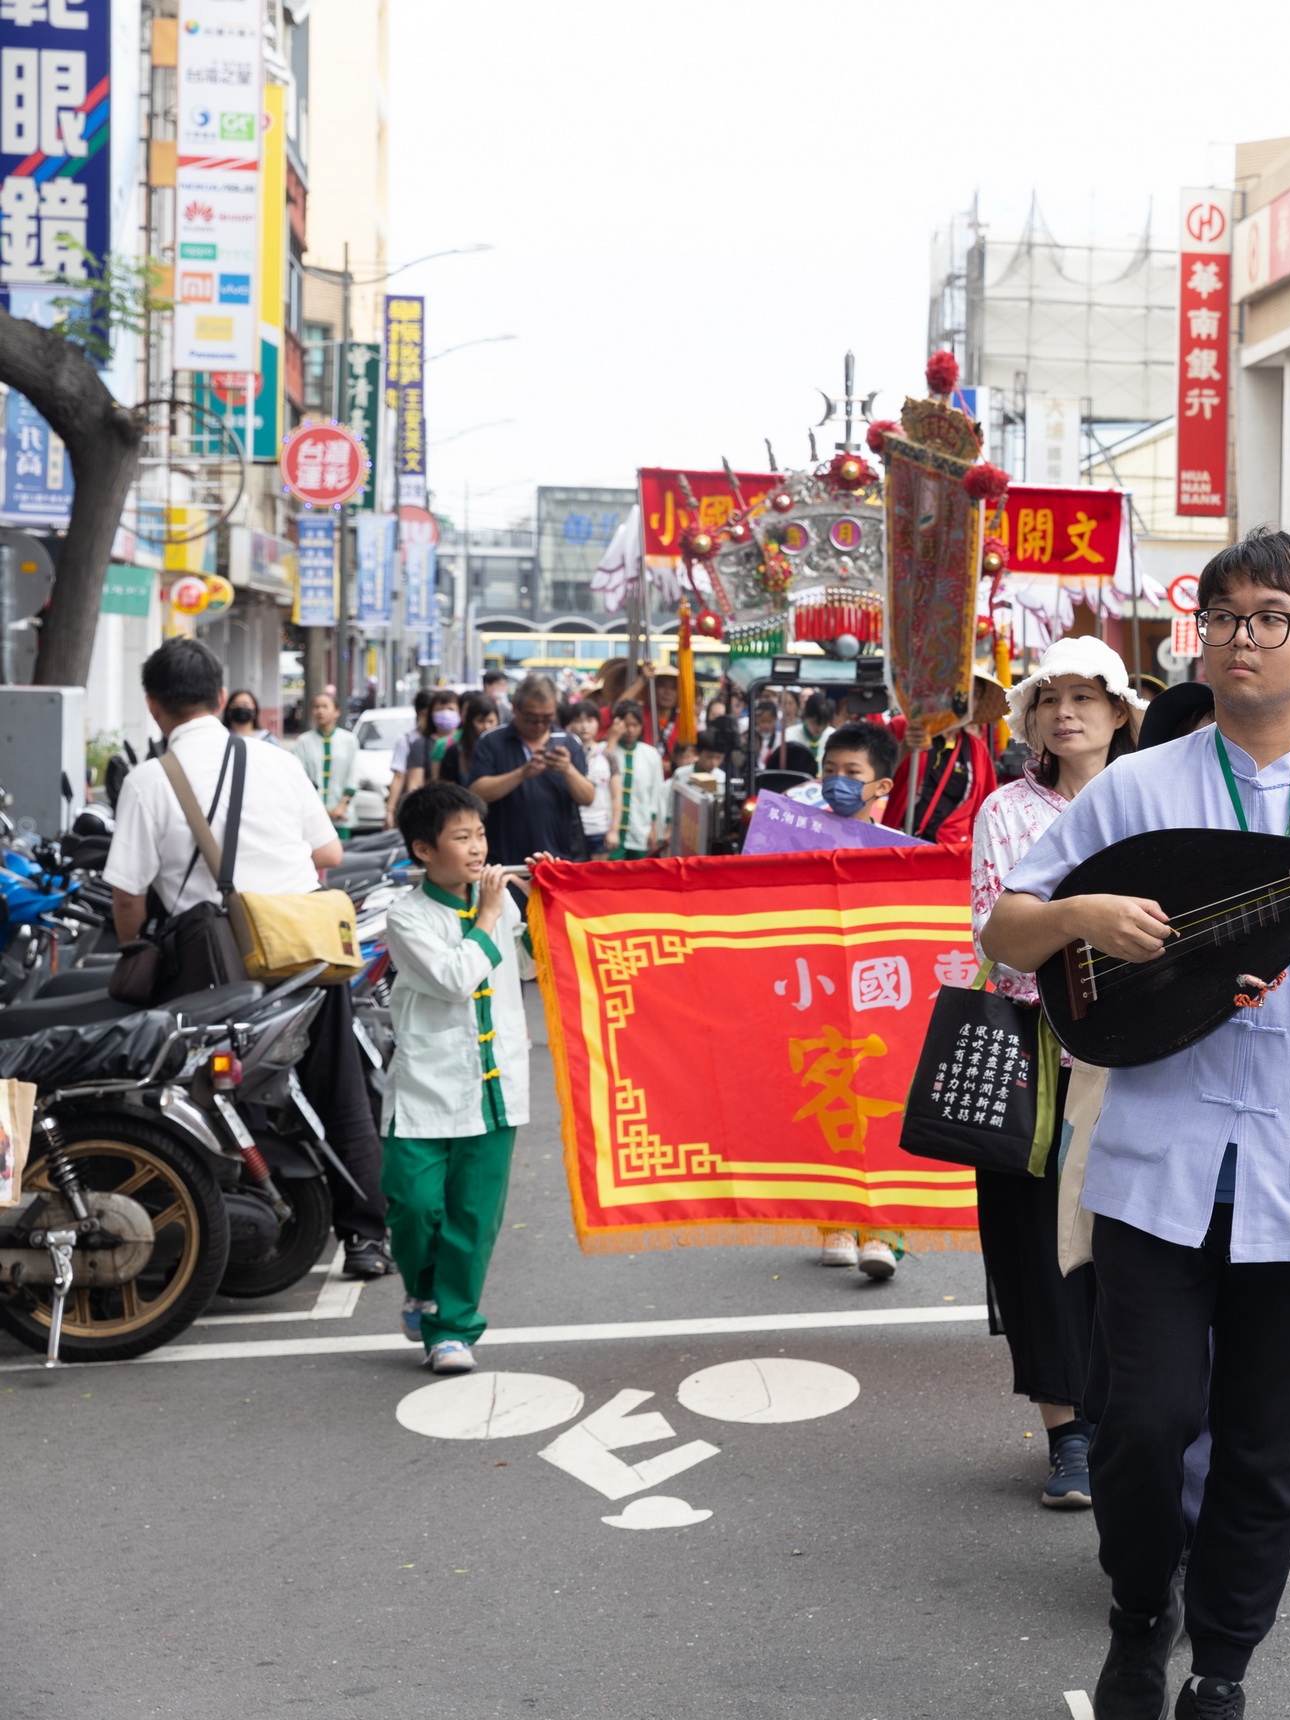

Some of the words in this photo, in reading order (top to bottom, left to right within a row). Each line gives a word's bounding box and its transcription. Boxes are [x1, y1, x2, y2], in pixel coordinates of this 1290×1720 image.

[1185, 262, 1223, 420] 華南銀行
[297, 438, 350, 464] 台灣
[1180, 470, 1211, 481] HUA
[1180, 483, 1211, 493] NAN
[1180, 494, 1222, 505] BANK
[1017, 1059, 1029, 1080] 彰化
[788, 1024, 905, 1155] 客
